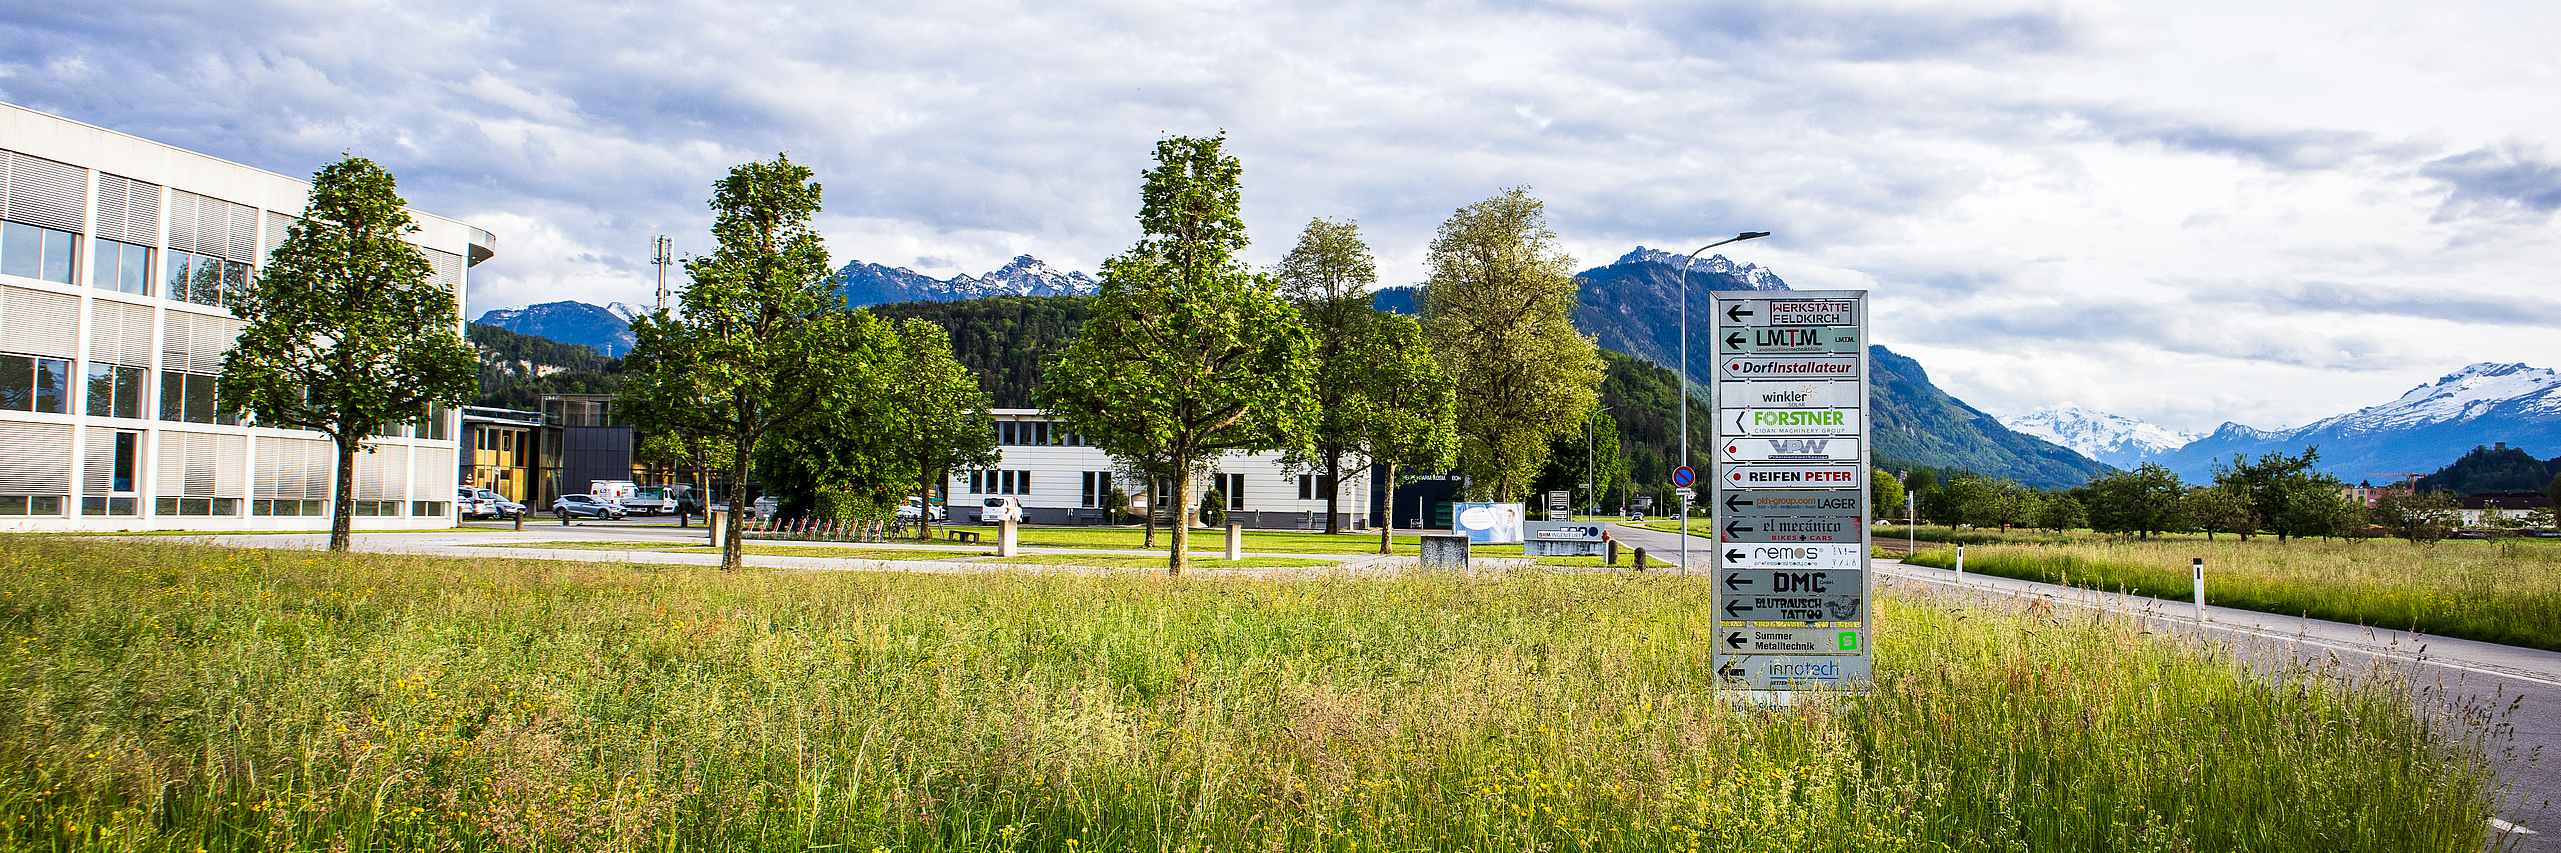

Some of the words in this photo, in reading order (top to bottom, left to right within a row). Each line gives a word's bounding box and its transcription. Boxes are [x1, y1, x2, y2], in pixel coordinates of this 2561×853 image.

[1773, 302, 1849, 312] WERKSTÄTTE
[1773, 314, 1839, 323] FELDKIRCH
[1756, 329, 1823, 347] LMTM
[1743, 362, 1852, 373] DorfInstallateur
[1762, 391, 1807, 402] winkler
[1755, 411, 1844, 426] FORSTNER
[1768, 440, 1829, 453] VPW
[1749, 472, 1800, 482] REIFEN
[1805, 472, 1851, 482] PETER
[1817, 498, 1855, 509] LAGER
[1763, 519, 1775, 532] el
[1779, 519, 1841, 532] mecánico
[1773, 571, 1827, 593] DMC
[1755, 598, 1823, 609] BLUTRAUSCH
[1781, 609, 1823, 619] TATTOO
[1755, 631, 1793, 640] Summer
[1755, 642, 1815, 650] Metalltechnik
[1769, 661, 1839, 676] innotech
